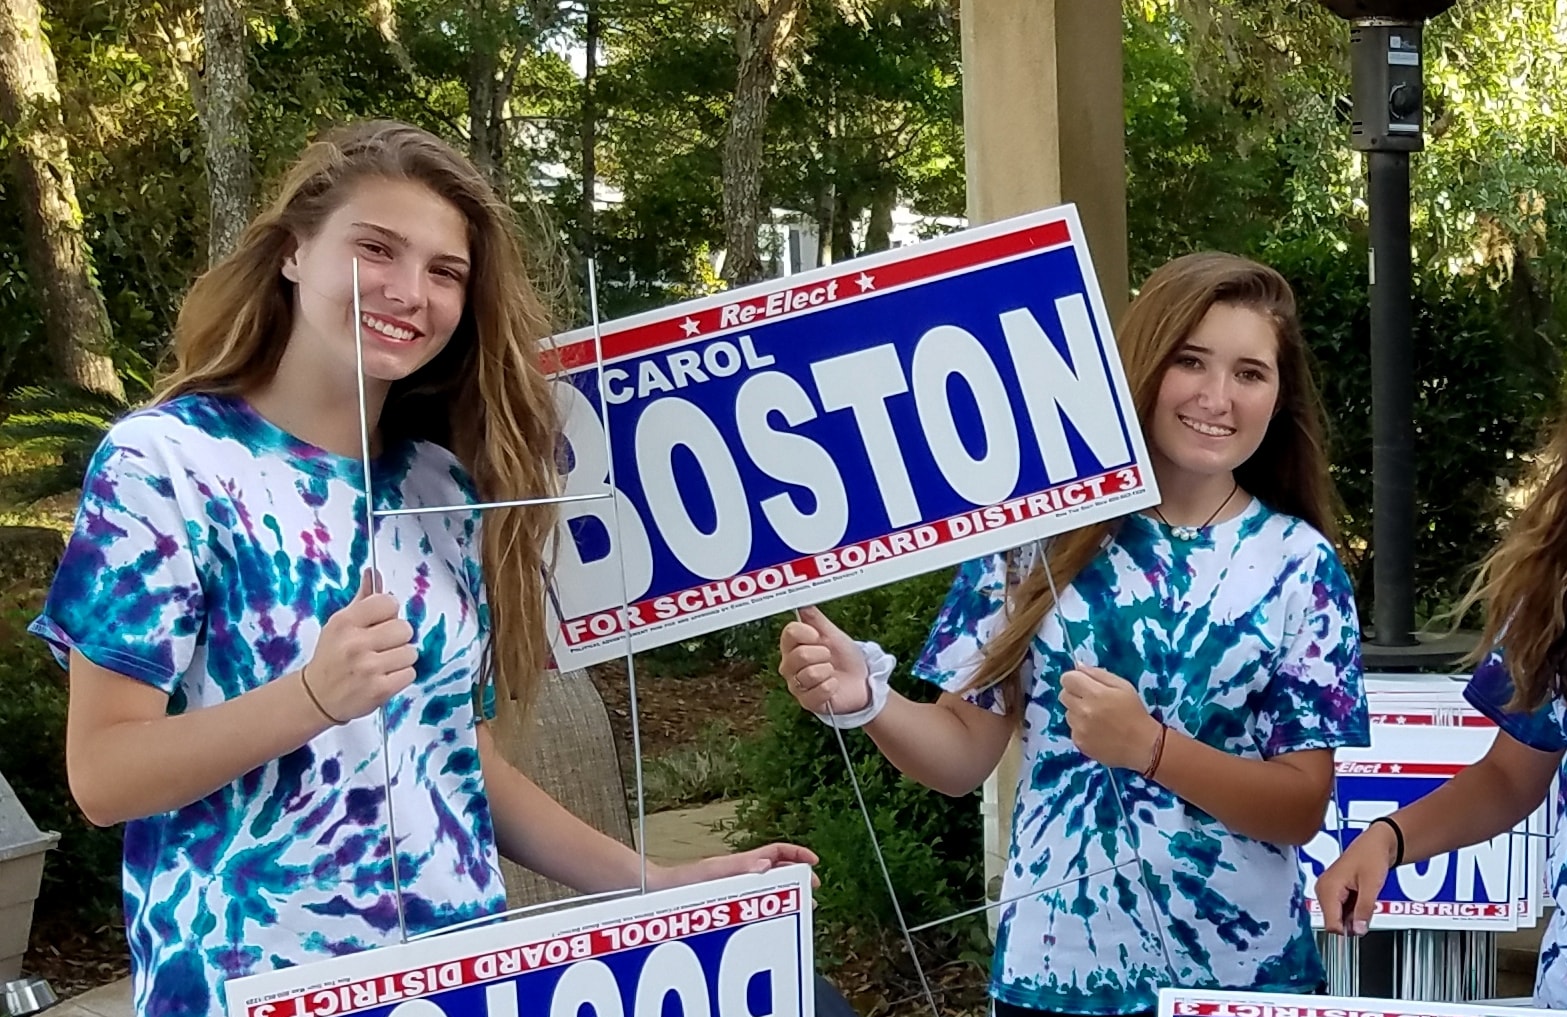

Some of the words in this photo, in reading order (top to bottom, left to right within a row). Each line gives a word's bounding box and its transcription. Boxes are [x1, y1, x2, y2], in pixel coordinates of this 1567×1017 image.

[719, 280, 838, 330] Re-Elect
[602, 335, 775, 405] CAROL
[543, 292, 1132, 622] BOSTON
[568, 605, 641, 643] FOR
[654, 562, 808, 619] SCHOOL
[814, 522, 939, 576] BOARD
[948, 476, 1106, 536] DISTRICT
[1116, 469, 1138, 491] 3
[602, 902, 731, 954] SCHOOL
[745, 888, 798, 924] FOR
[1389, 902, 1488, 916] DISTRICT
[1494, 905, 1506, 917] 3
[475, 930, 592, 983] BOARD
[1178, 1002, 1199, 1016] 3
